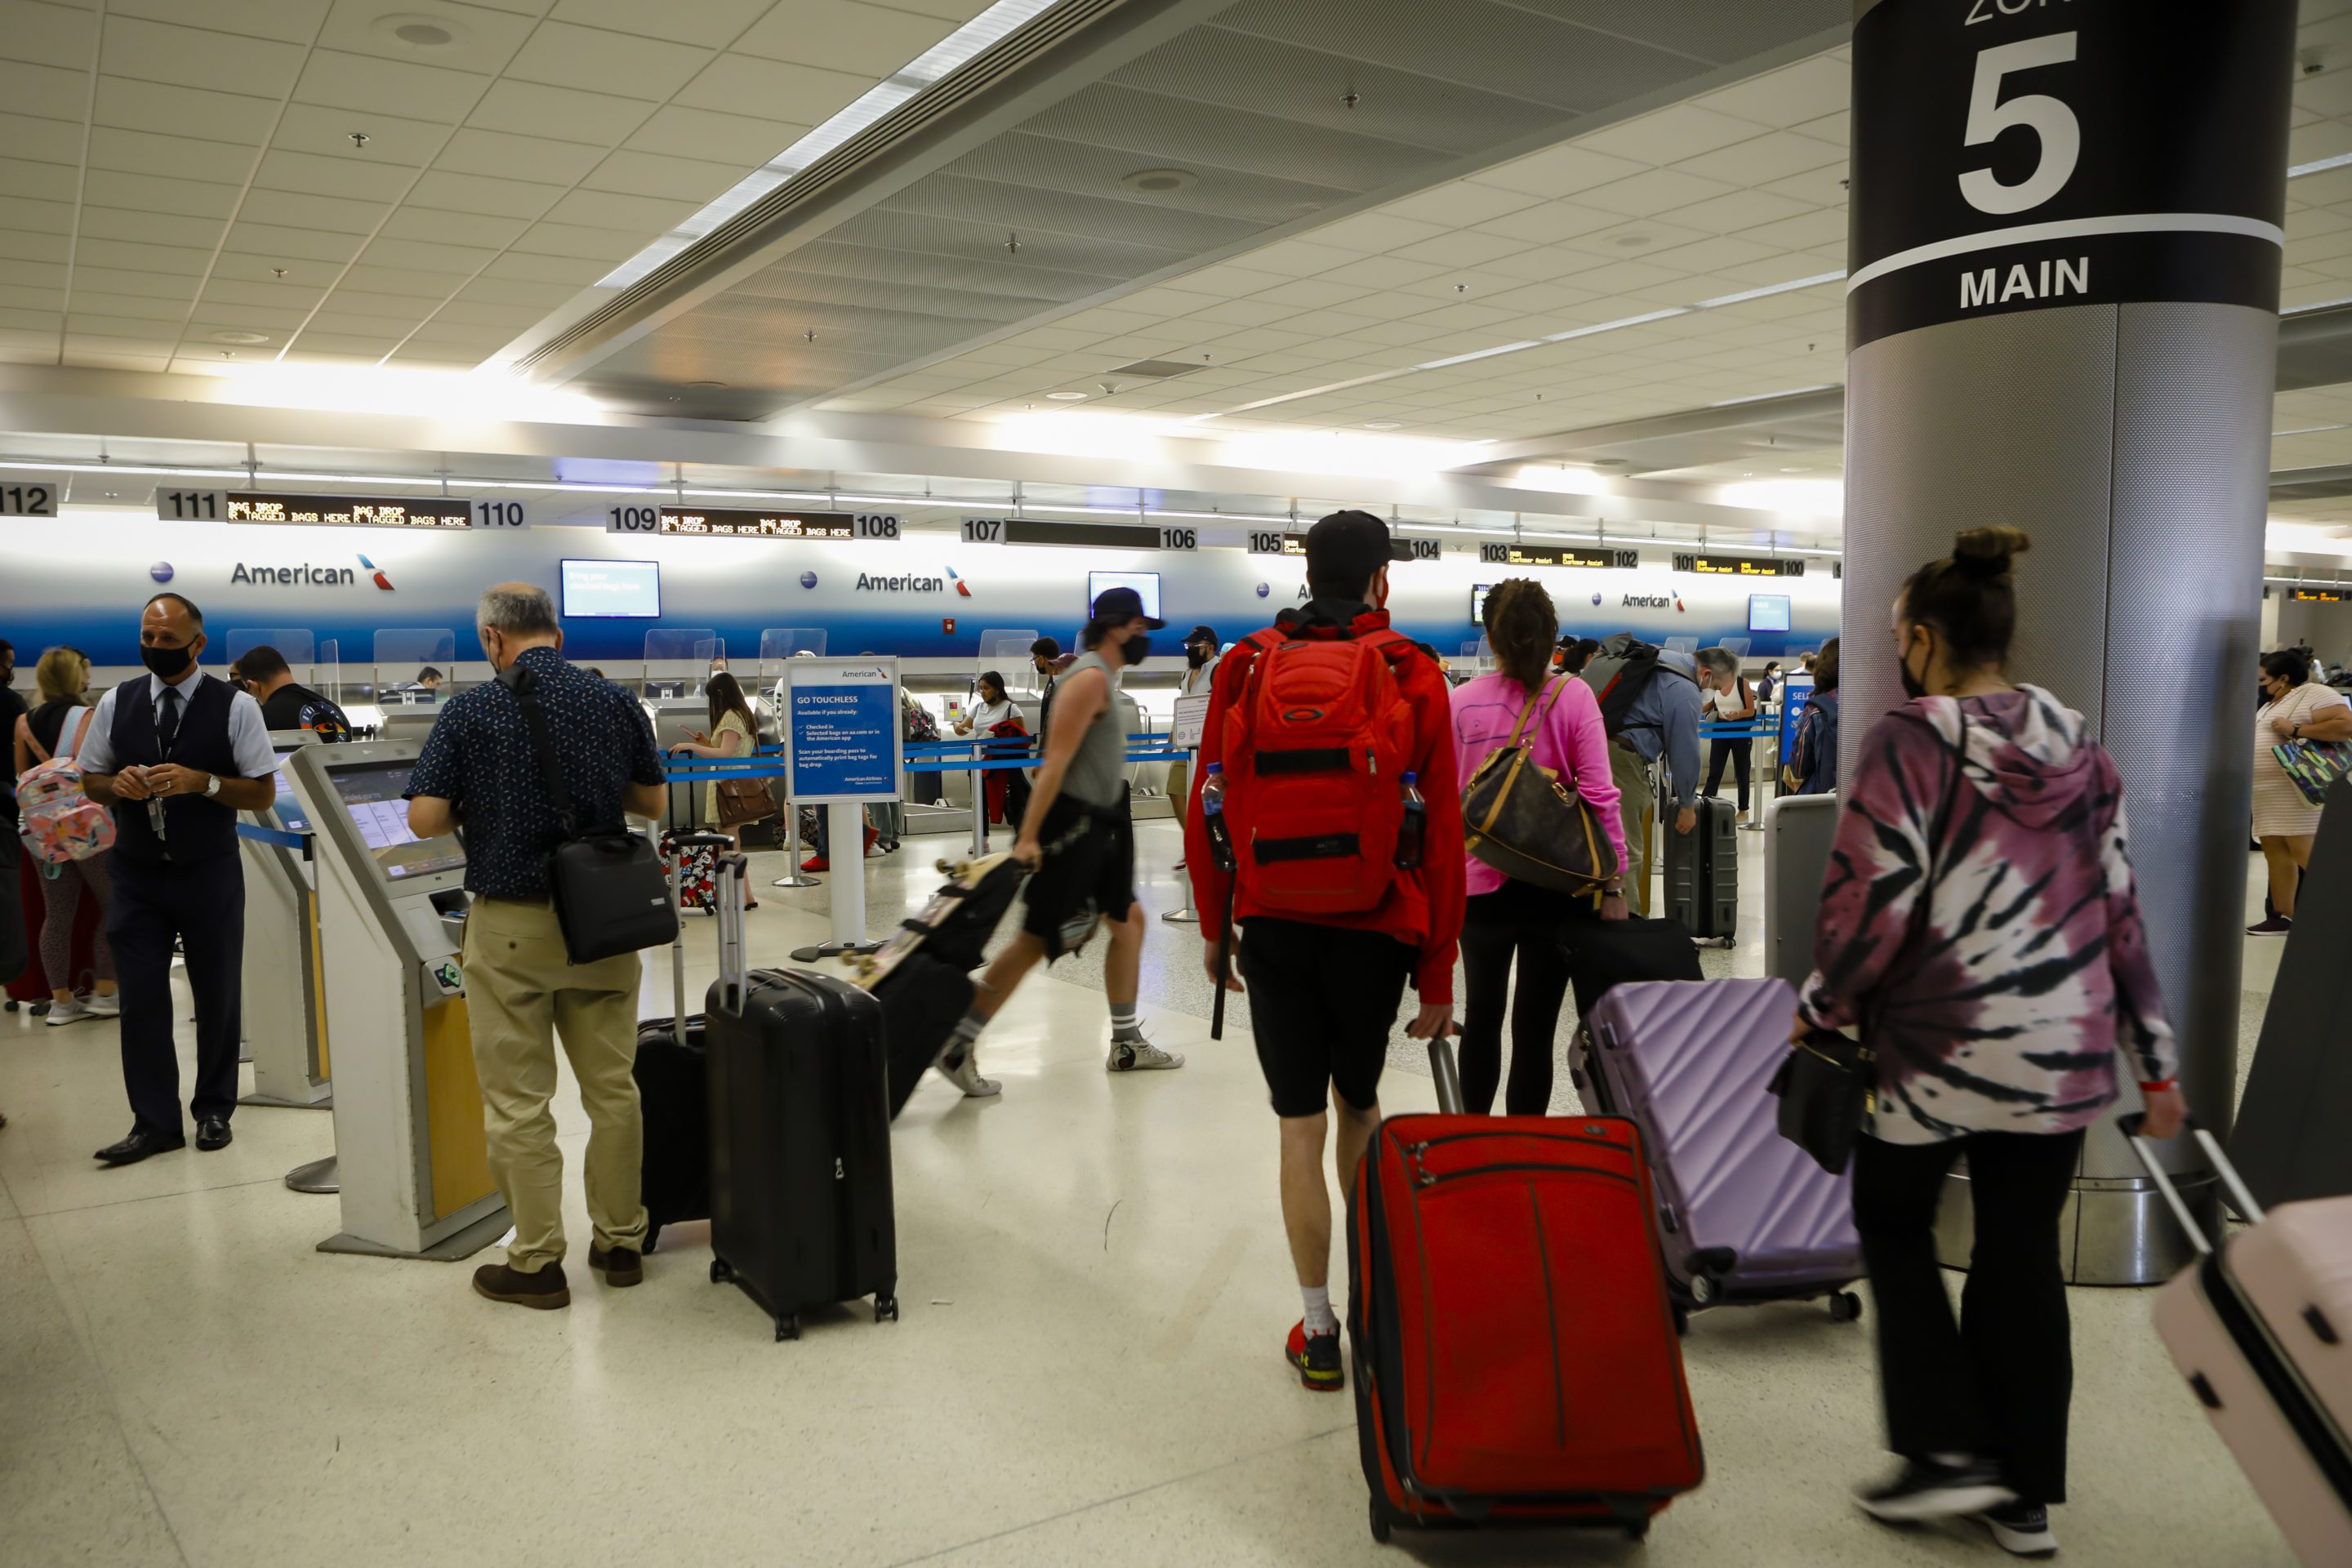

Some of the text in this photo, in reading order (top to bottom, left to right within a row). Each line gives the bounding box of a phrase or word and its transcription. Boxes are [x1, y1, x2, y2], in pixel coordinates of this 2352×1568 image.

[1958, 31, 2080, 215] 5
[1961, 257, 2088, 309] MAIN
[169, 492, 215, 518] 111
[228, 501, 283, 513] BAG DROP
[353, 506, 405, 516] BAG DROP
[245, 511, 286, 521] TAGGED
[292, 513, 318, 523] BAGS
[324, 514, 351, 523] HERE
[367, 515, 405, 524] TAGGED
[411, 516, 436, 525] BAGS
[440, 517, 466, 526] HERE
[479, 502, 524, 527] 110
[610, 507, 657, 531] 109
[661, 516, 705, 525] BAG DROP
[676, 524, 708, 532] TAGGED
[712, 525, 734, 533] BAGS
[737, 526, 759, 535] HERE
[760, 519, 801, 528] BAG DROP
[858, 515, 898, 537] 108
[964, 520, 1001, 541] 107
[772, 527, 802, 535] TAGGED
[806, 528, 826, 537] BAGS
[1163, 529, 1196, 549] 106
[1250, 533, 1281, 552] 105
[1413, 541, 1440, 559] 104
[1482, 545, 1508, 562] 103
[1615, 551, 1637, 567] 102
[1676, 555, 1695, 571] 101
[1785, 561, 1803, 576] 100
[231, 562, 354, 584] American
[856, 572, 943, 591] American
[1622, 593, 1670, 608] American
[812, 696, 858, 704] TOUCHLESS
